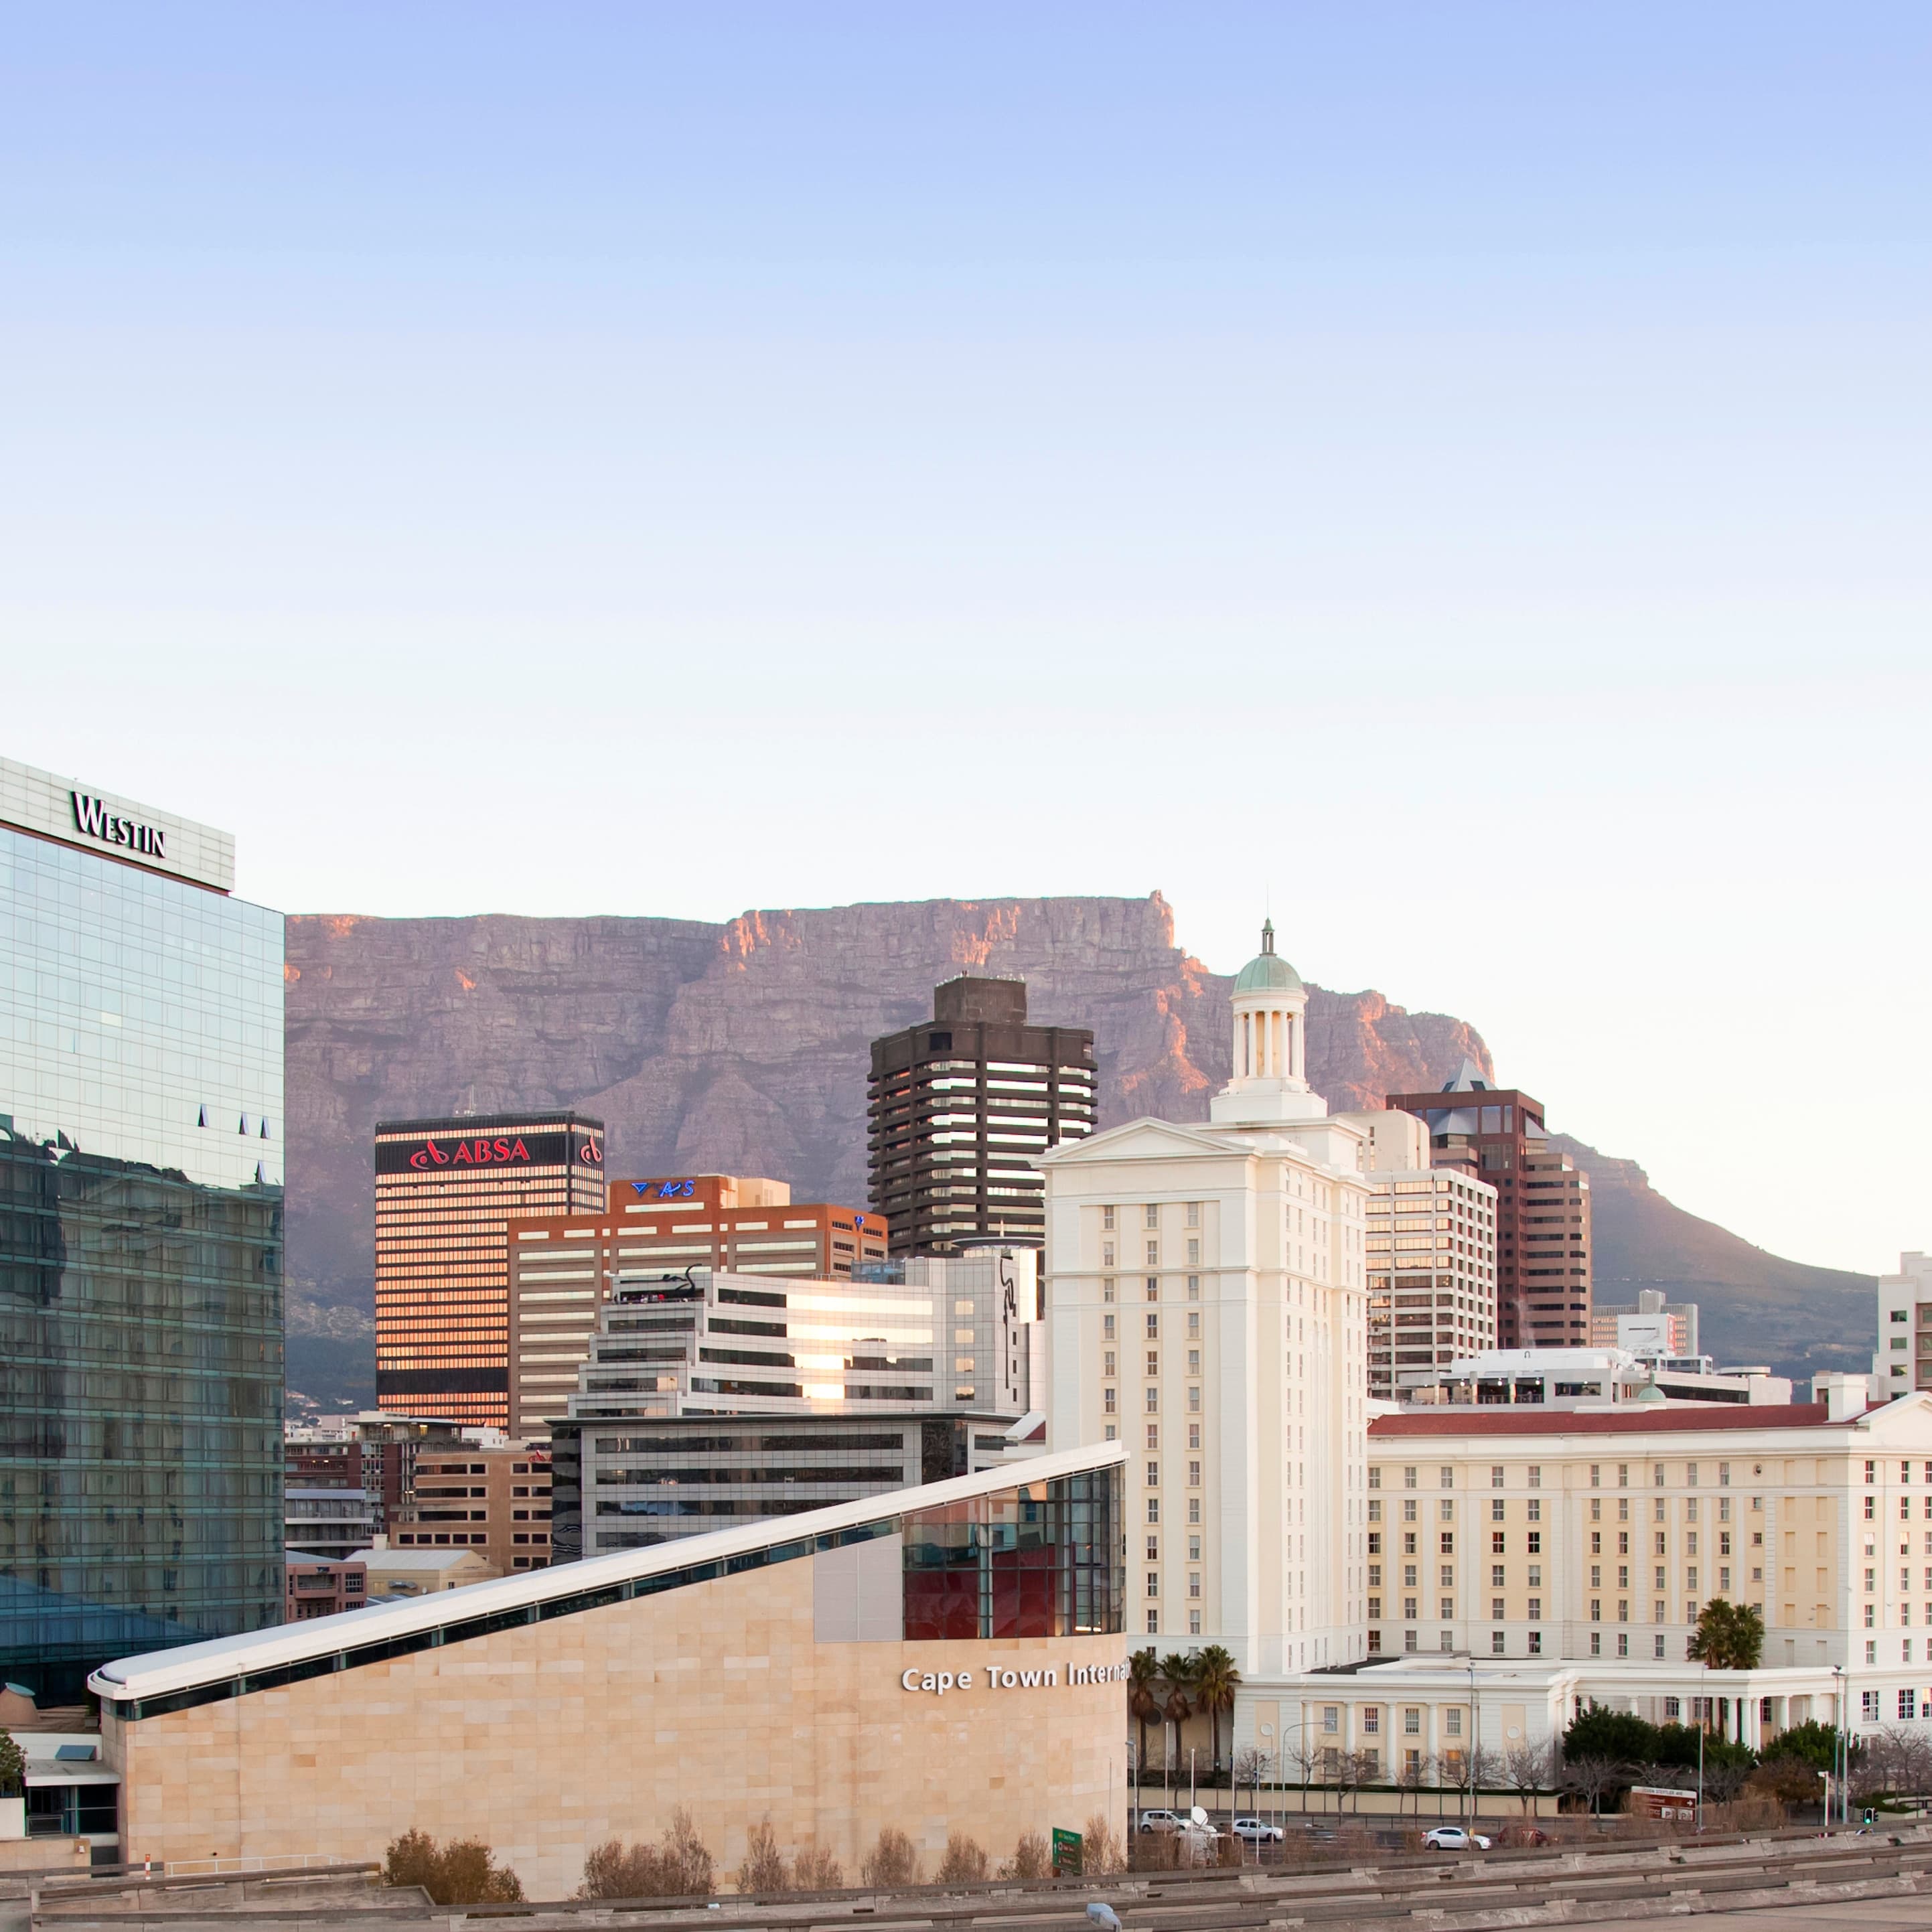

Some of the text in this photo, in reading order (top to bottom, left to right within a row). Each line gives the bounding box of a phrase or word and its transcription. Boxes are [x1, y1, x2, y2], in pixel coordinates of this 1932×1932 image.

[72, 791, 166, 858] WESTIN
[453, 1137, 530, 1164] ABSA
[901, 1668, 972, 1696] Cape
[986, 1666, 1057, 1688] Town
